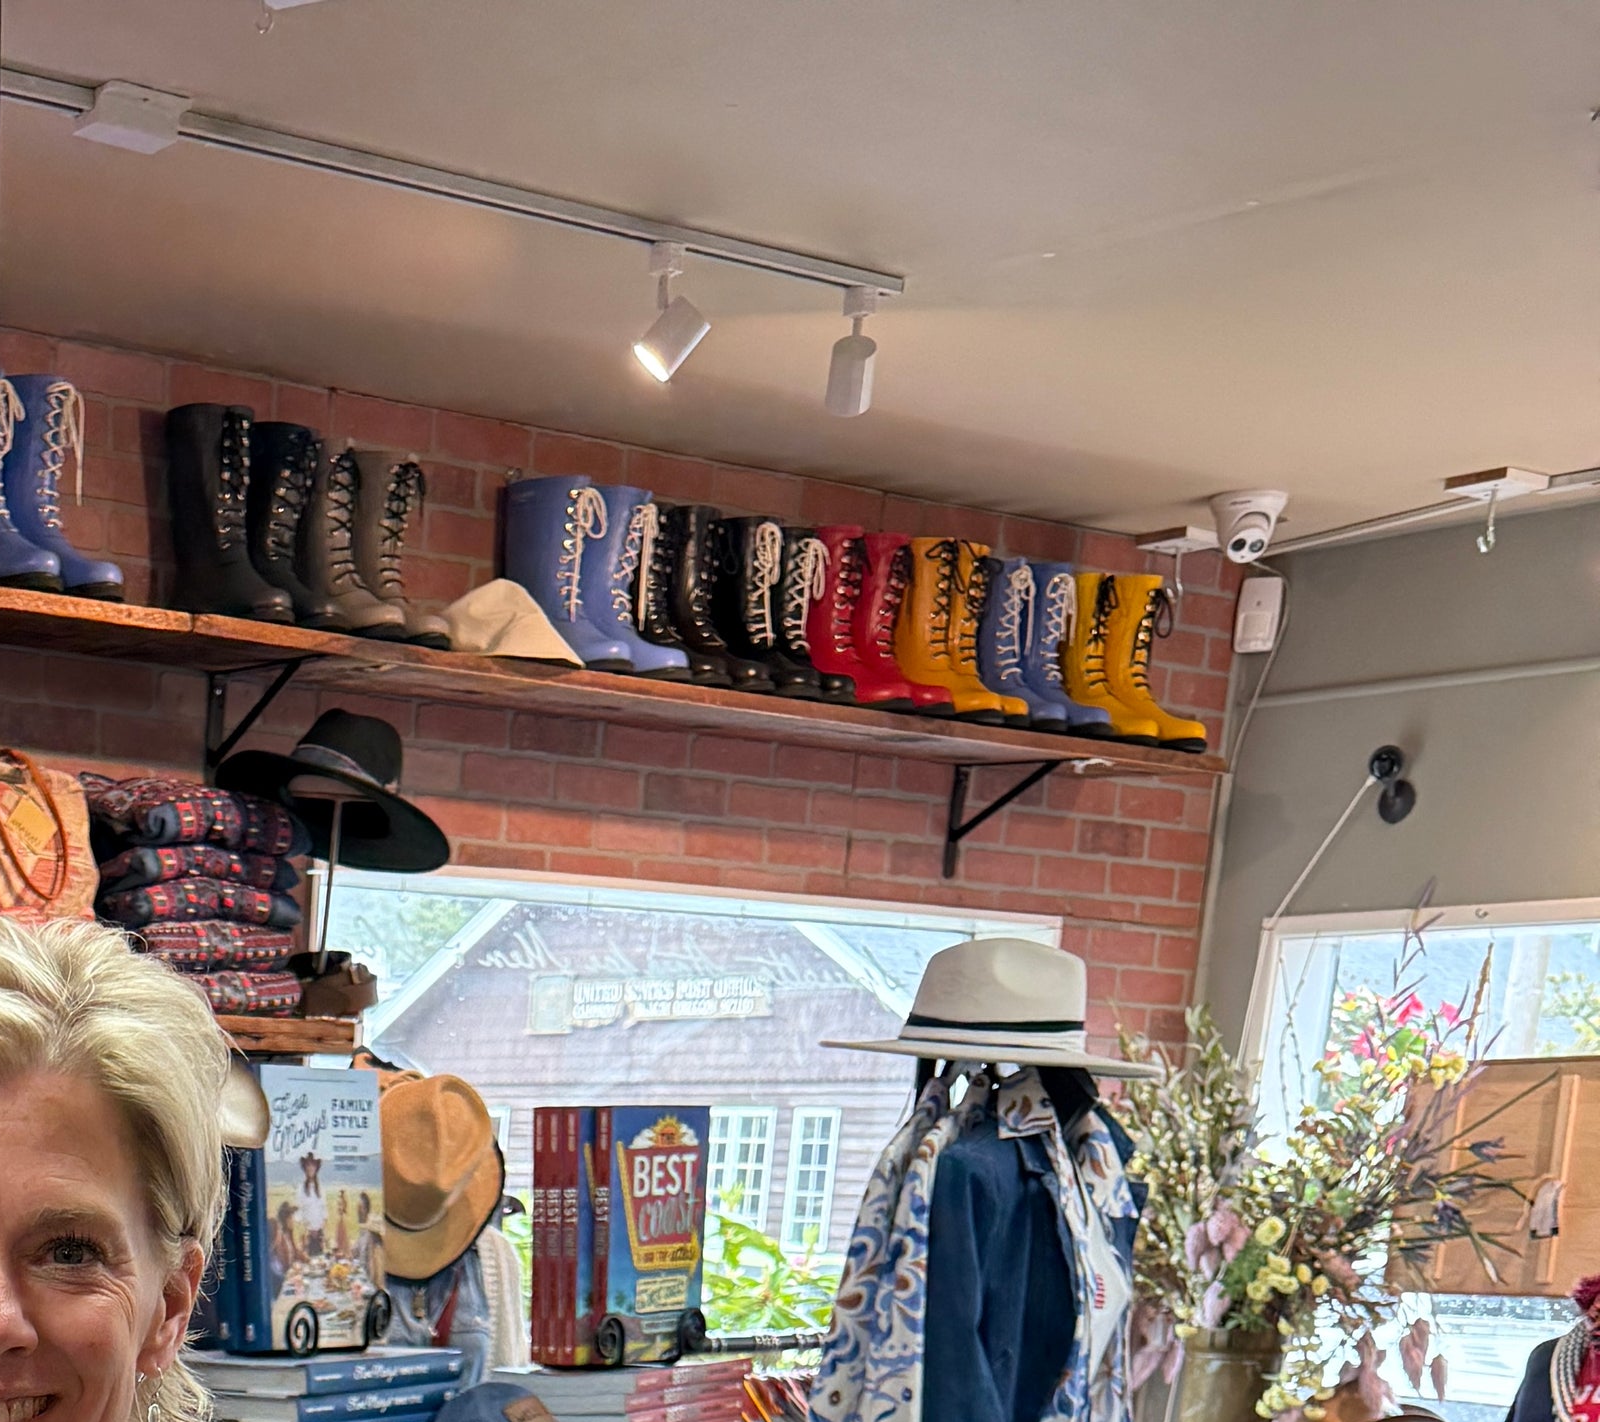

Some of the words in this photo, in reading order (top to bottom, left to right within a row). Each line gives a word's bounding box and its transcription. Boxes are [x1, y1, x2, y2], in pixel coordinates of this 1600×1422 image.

[331, 1098, 374, 1112] FAMILY
[331, 1114, 369, 1129] STYLE
[632, 1154, 699, 1198] BEST
[563, 1189, 578, 1223] BEST
[595, 1187, 610, 1222] BEST
